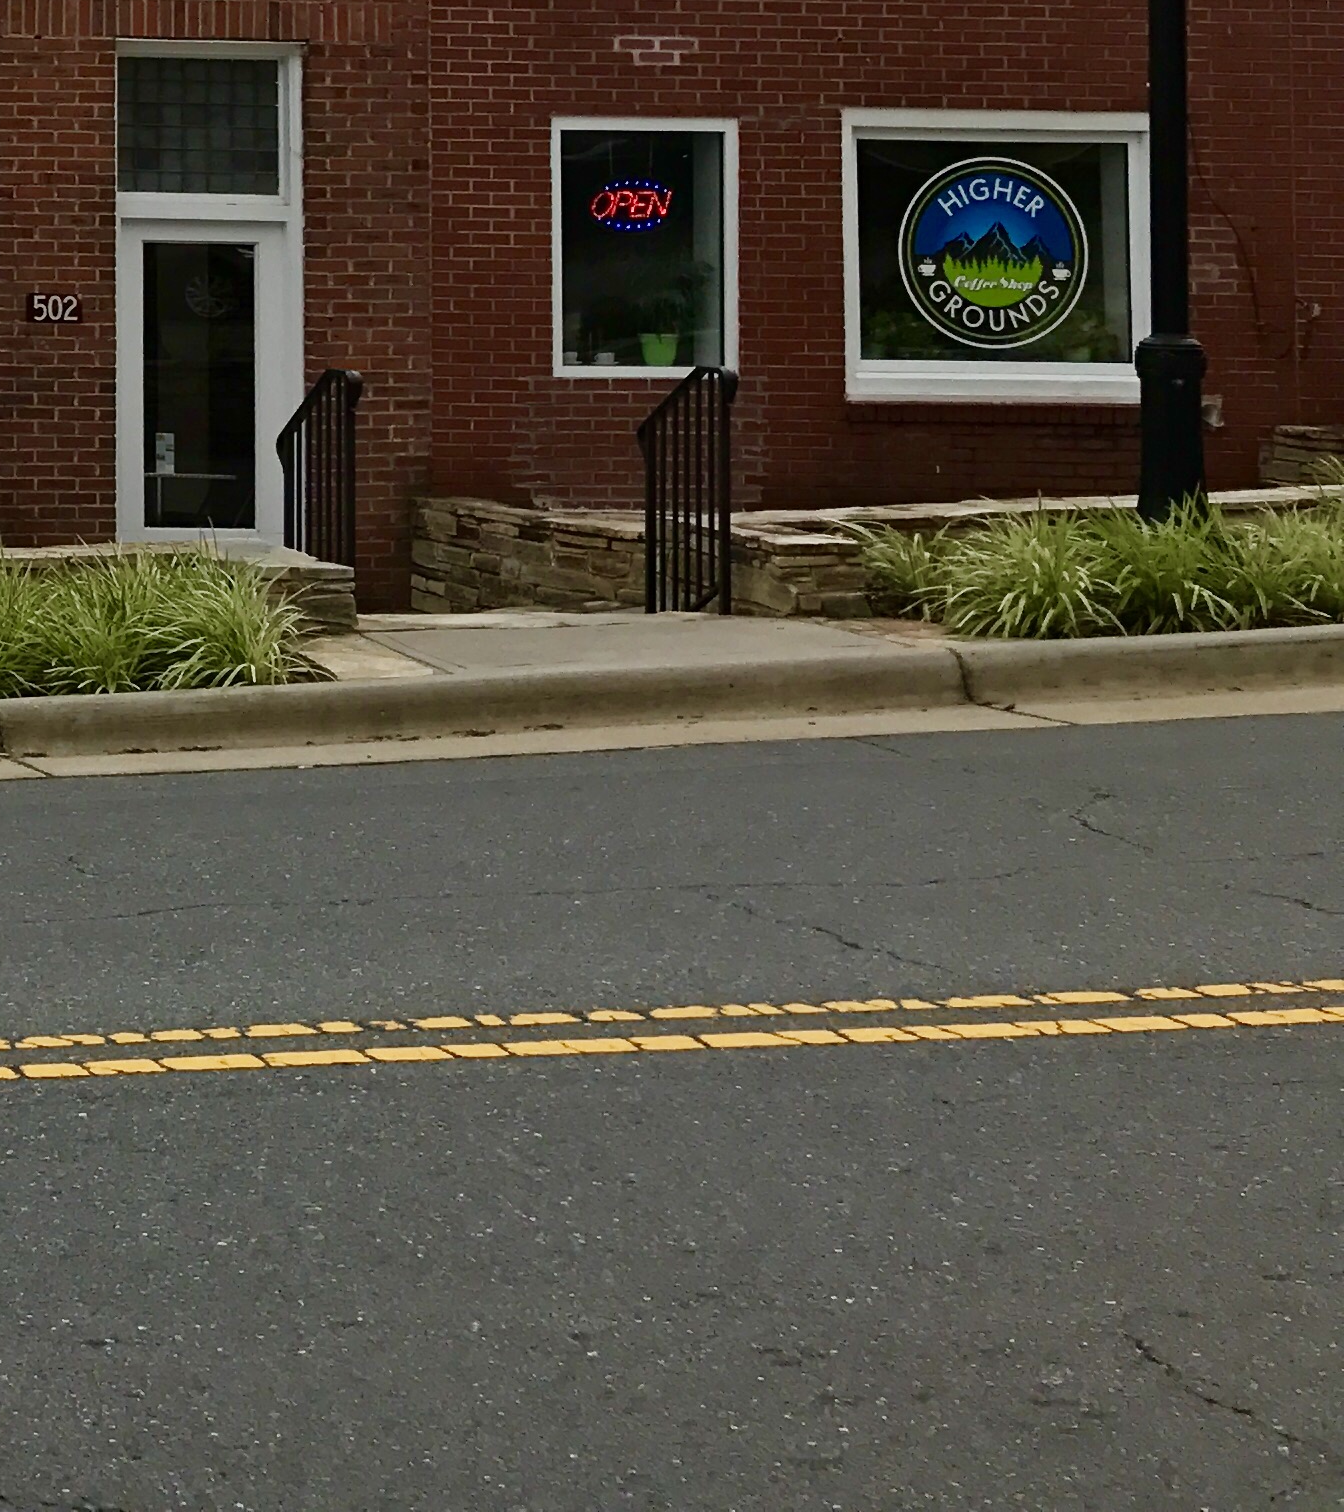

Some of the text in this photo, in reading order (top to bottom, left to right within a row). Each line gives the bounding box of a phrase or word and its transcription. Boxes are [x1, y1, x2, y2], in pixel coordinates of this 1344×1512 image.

[591, 190, 673, 219] OPEN
[937, 178, 1045, 218] HIGHER
[33, 295, 78, 321] 502
[929, 280, 1060, 332] GROUNDS
